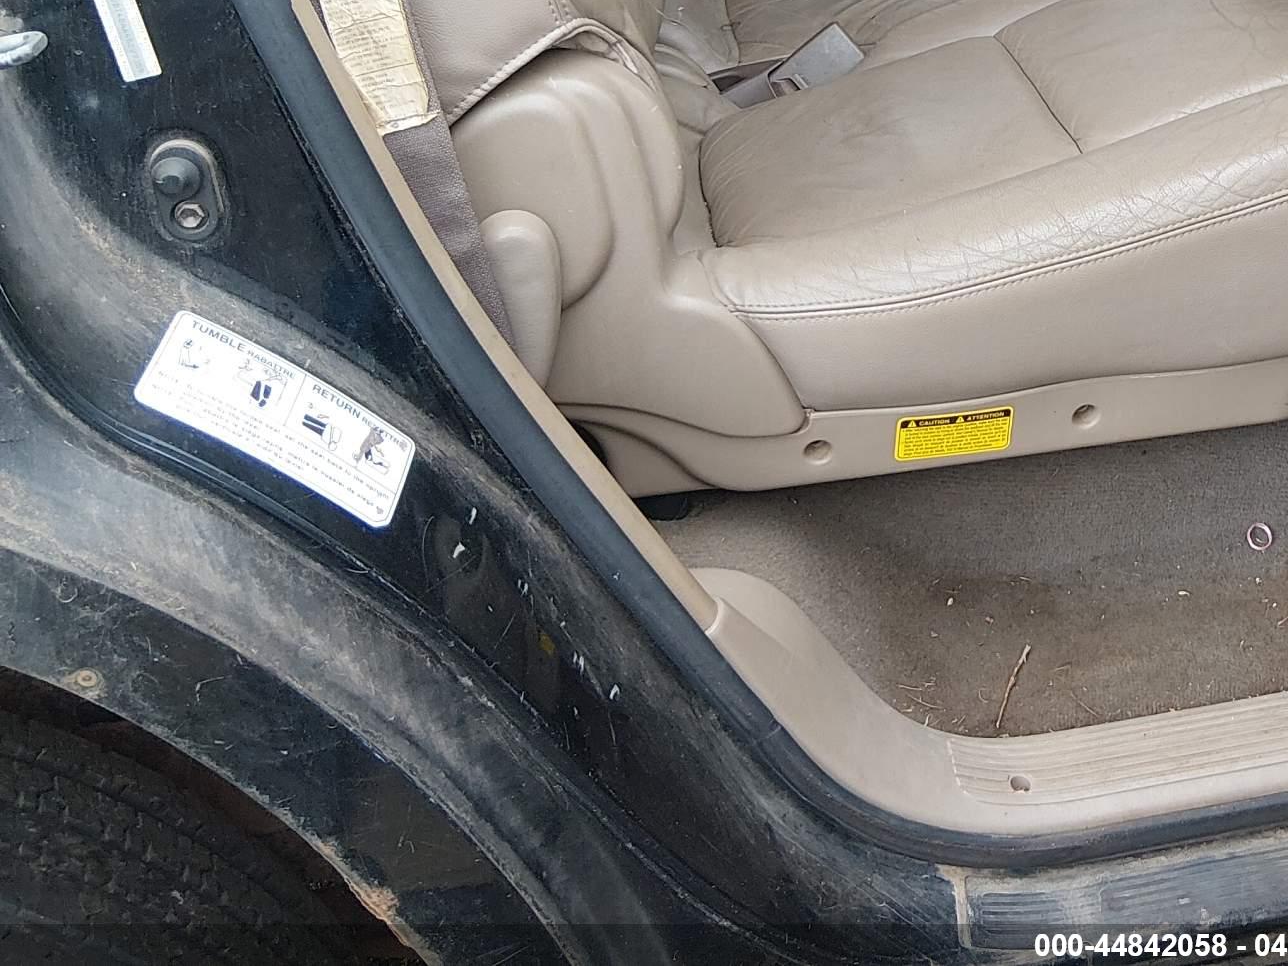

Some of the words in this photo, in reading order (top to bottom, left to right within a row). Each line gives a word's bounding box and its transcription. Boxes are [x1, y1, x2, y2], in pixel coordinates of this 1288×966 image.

[192, 320, 247, 353] TUMBLE
[312, 384, 361, 419] RETURN
[918, 418, 951, 426] CAUTION
[966, 411, 1005, 421] ATTENTION
